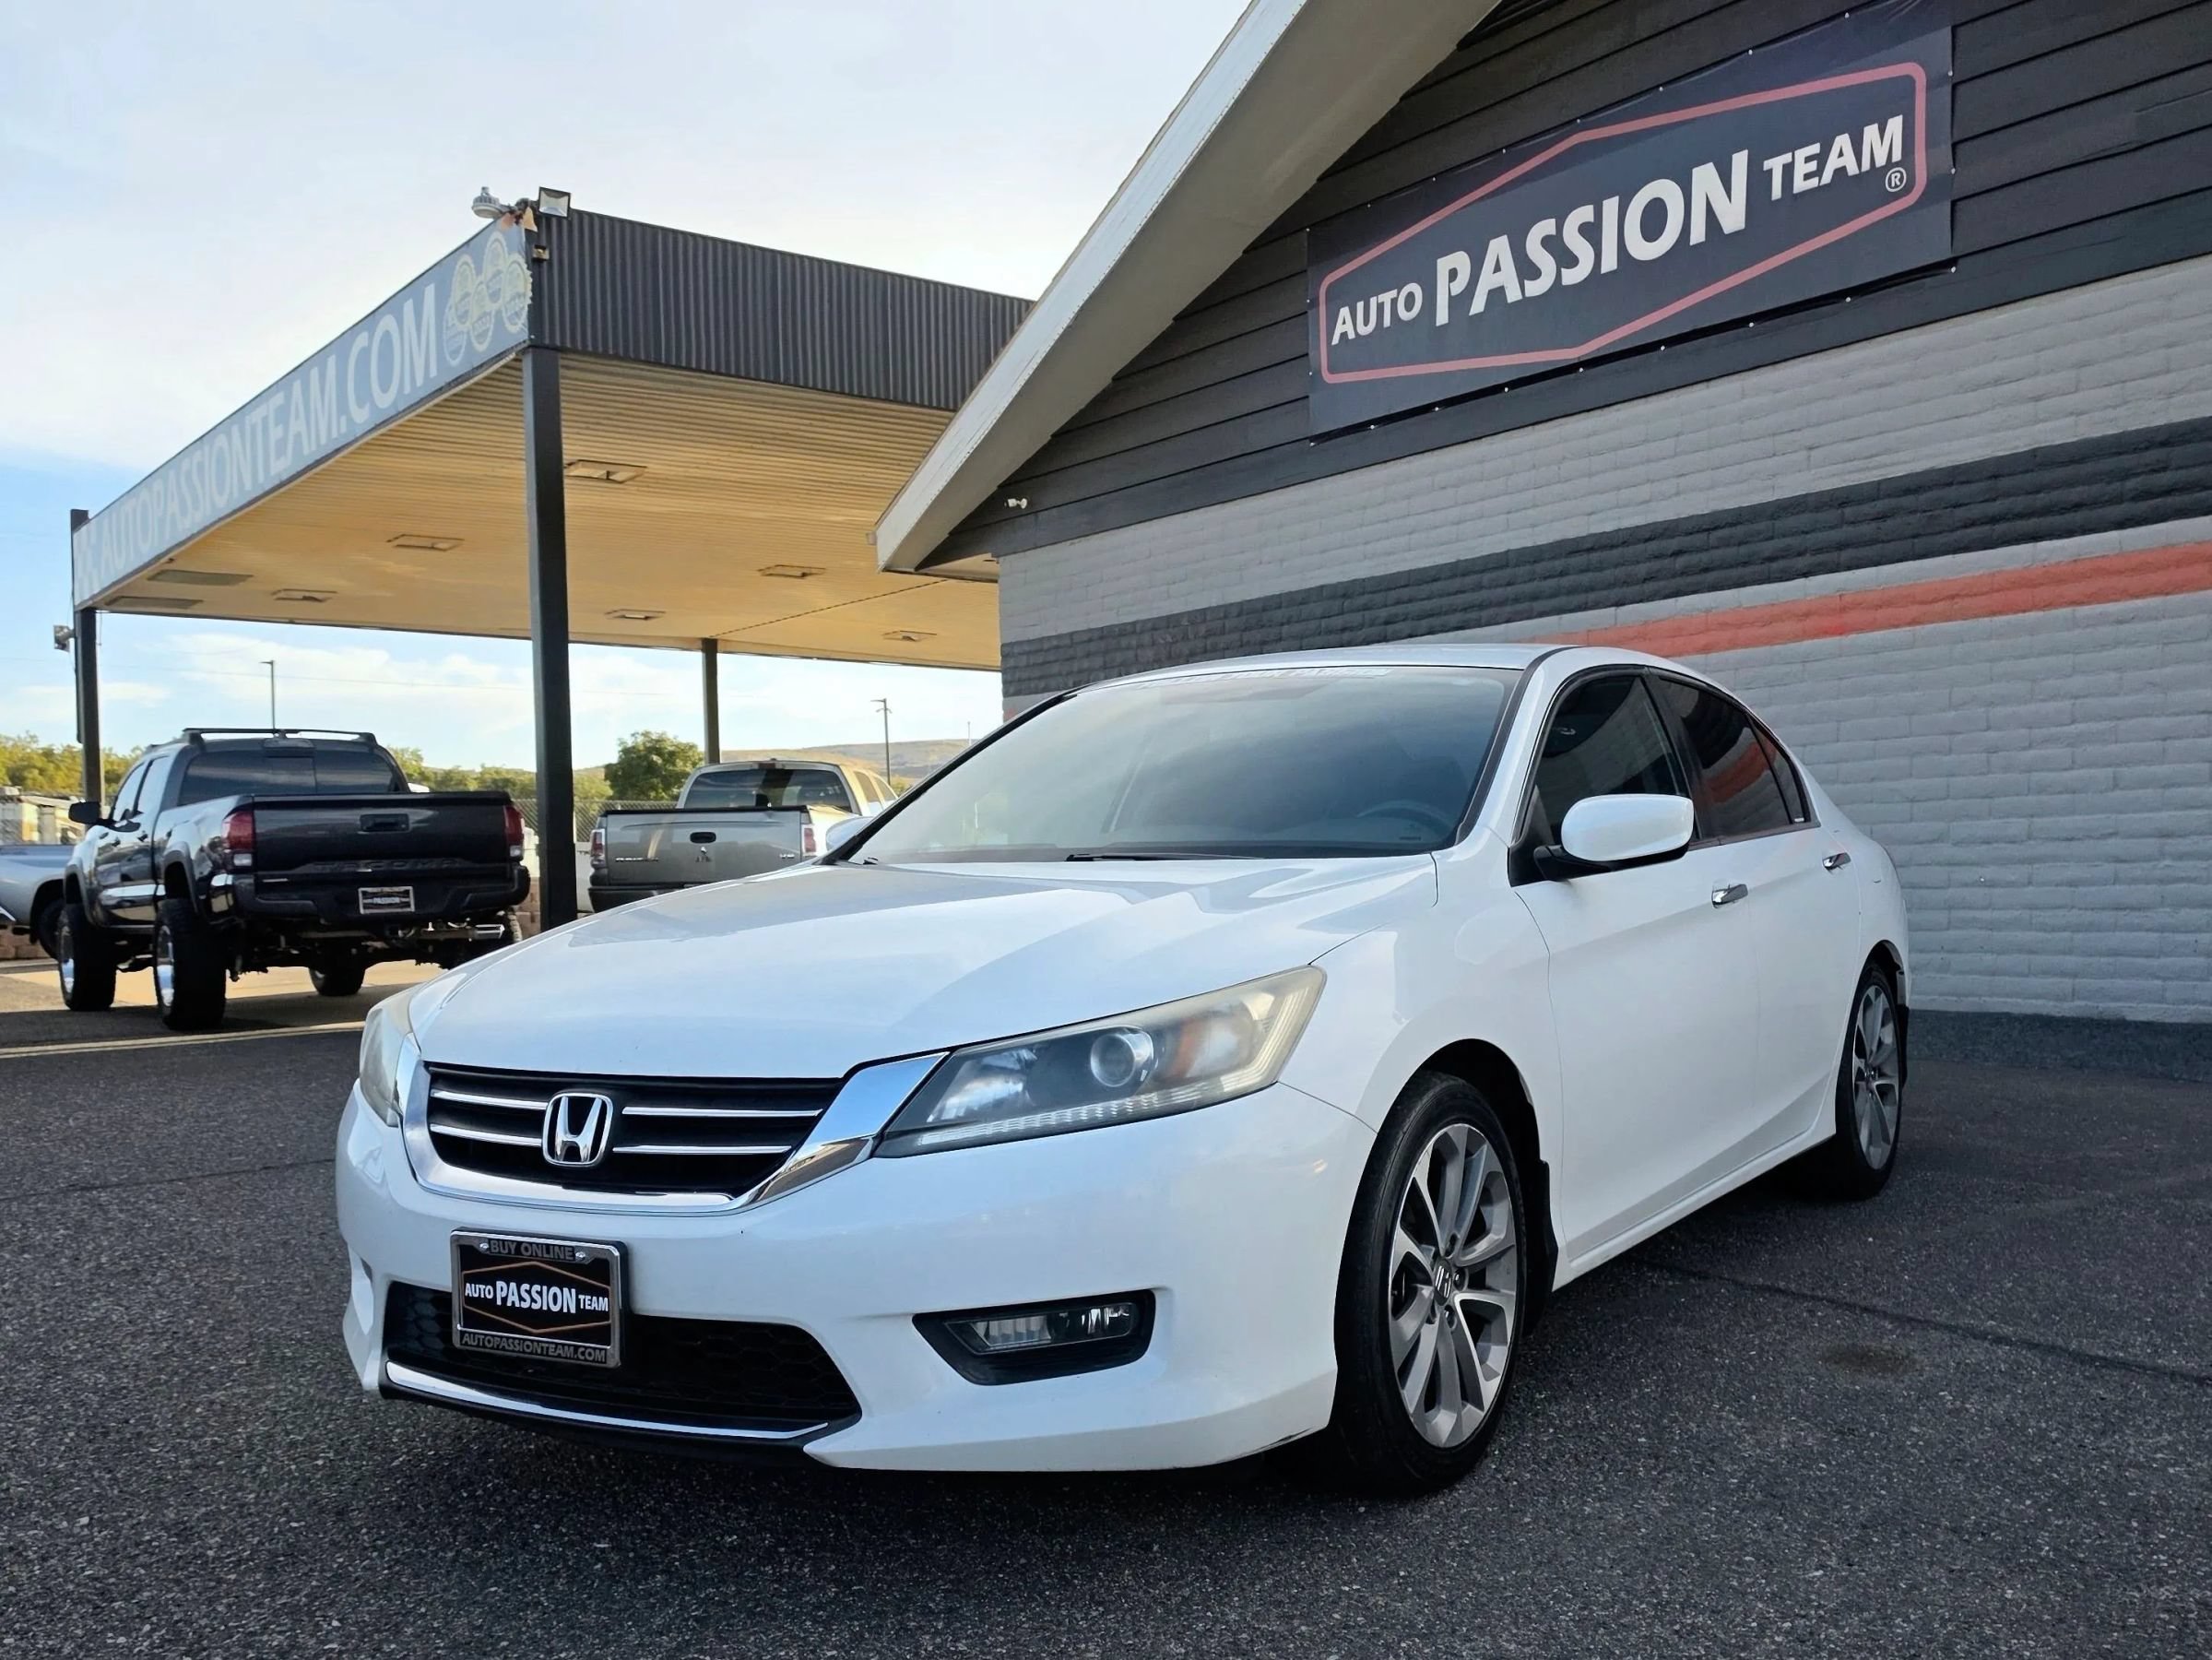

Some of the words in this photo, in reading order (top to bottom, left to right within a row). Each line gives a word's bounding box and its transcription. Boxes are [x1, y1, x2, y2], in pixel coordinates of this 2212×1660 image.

[1331, 281, 1423, 345] AUTO
[1436, 149, 1748, 326] PASSION
[1763, 114, 1904, 200] TEAM
[101, 282, 438, 579] AUTOPASSIONTEAM.COM
[490, 1239, 516, 1255] BUY
[521, 1243, 574, 1260] ONLINE
[465, 1283, 493, 1298] AUTO
[496, 1280, 576, 1313] PASSION
[578, 1295, 609, 1311] TEAM
[462, 1333, 606, 1362] AUTOPASSIONTEAM.COM
